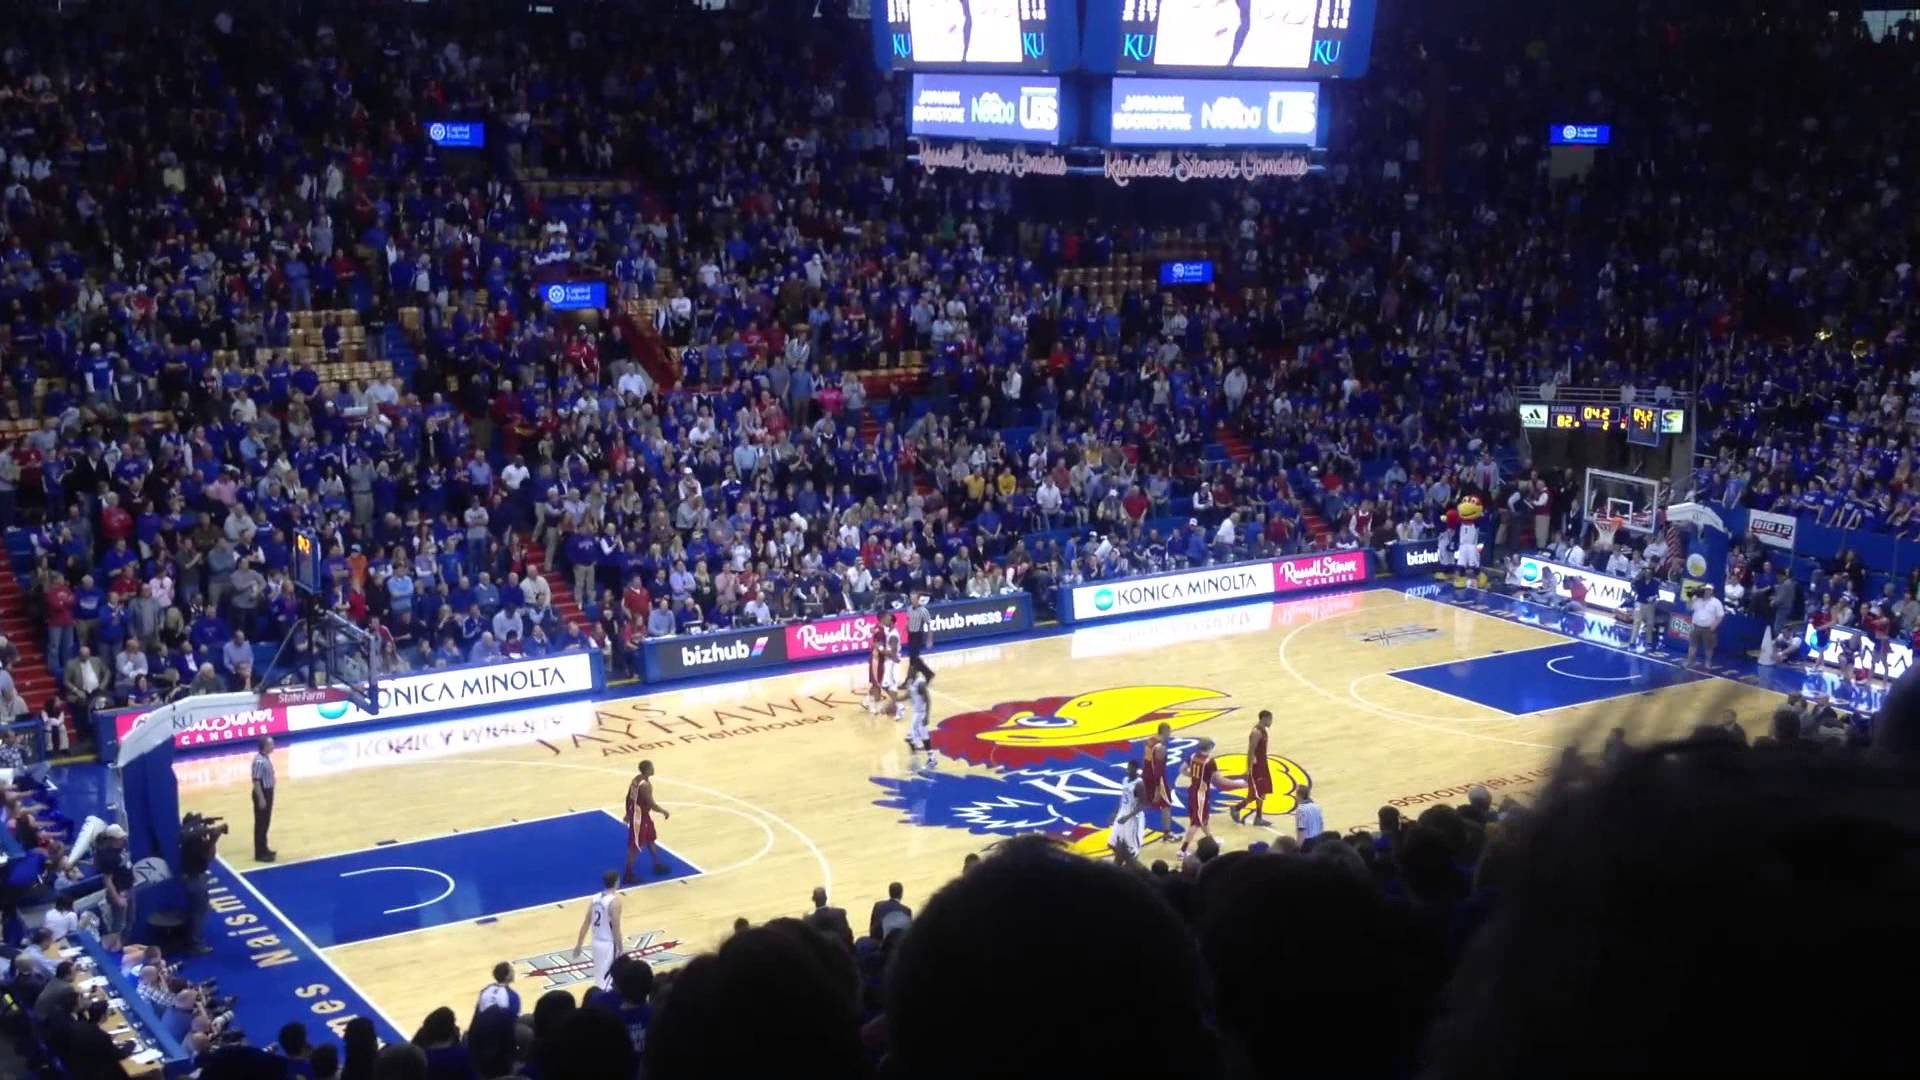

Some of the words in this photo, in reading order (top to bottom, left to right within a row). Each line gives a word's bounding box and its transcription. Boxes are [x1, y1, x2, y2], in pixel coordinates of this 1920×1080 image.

[893, 33, 911, 58] KU
[1023, 32, 1045, 58] KU
[1123, 34, 1154, 60] KU
[1313, 40, 1341, 65] KU
[1753, 519, 1775, 531] BIG
[1777, 523, 1792, 534] 12
[1406, 549, 1440, 566] bizhu
[1279, 560, 1322, 583] Russell
[1118, 582, 1183, 606] KONICA
[1187, 573, 1256, 597] MINOLTA
[965, 614, 1002, 625] PRESS
[797, 620, 853, 649] Russell
[681, 639, 750, 667] bizhub
[461, 667, 566, 698] MINOLTA
[181, 724, 268, 745] CANDIES
[601, 739, 674, 757] Allen
[680, 713, 835, 745] Fieldhouse
[594, 911, 601, 927] 2
